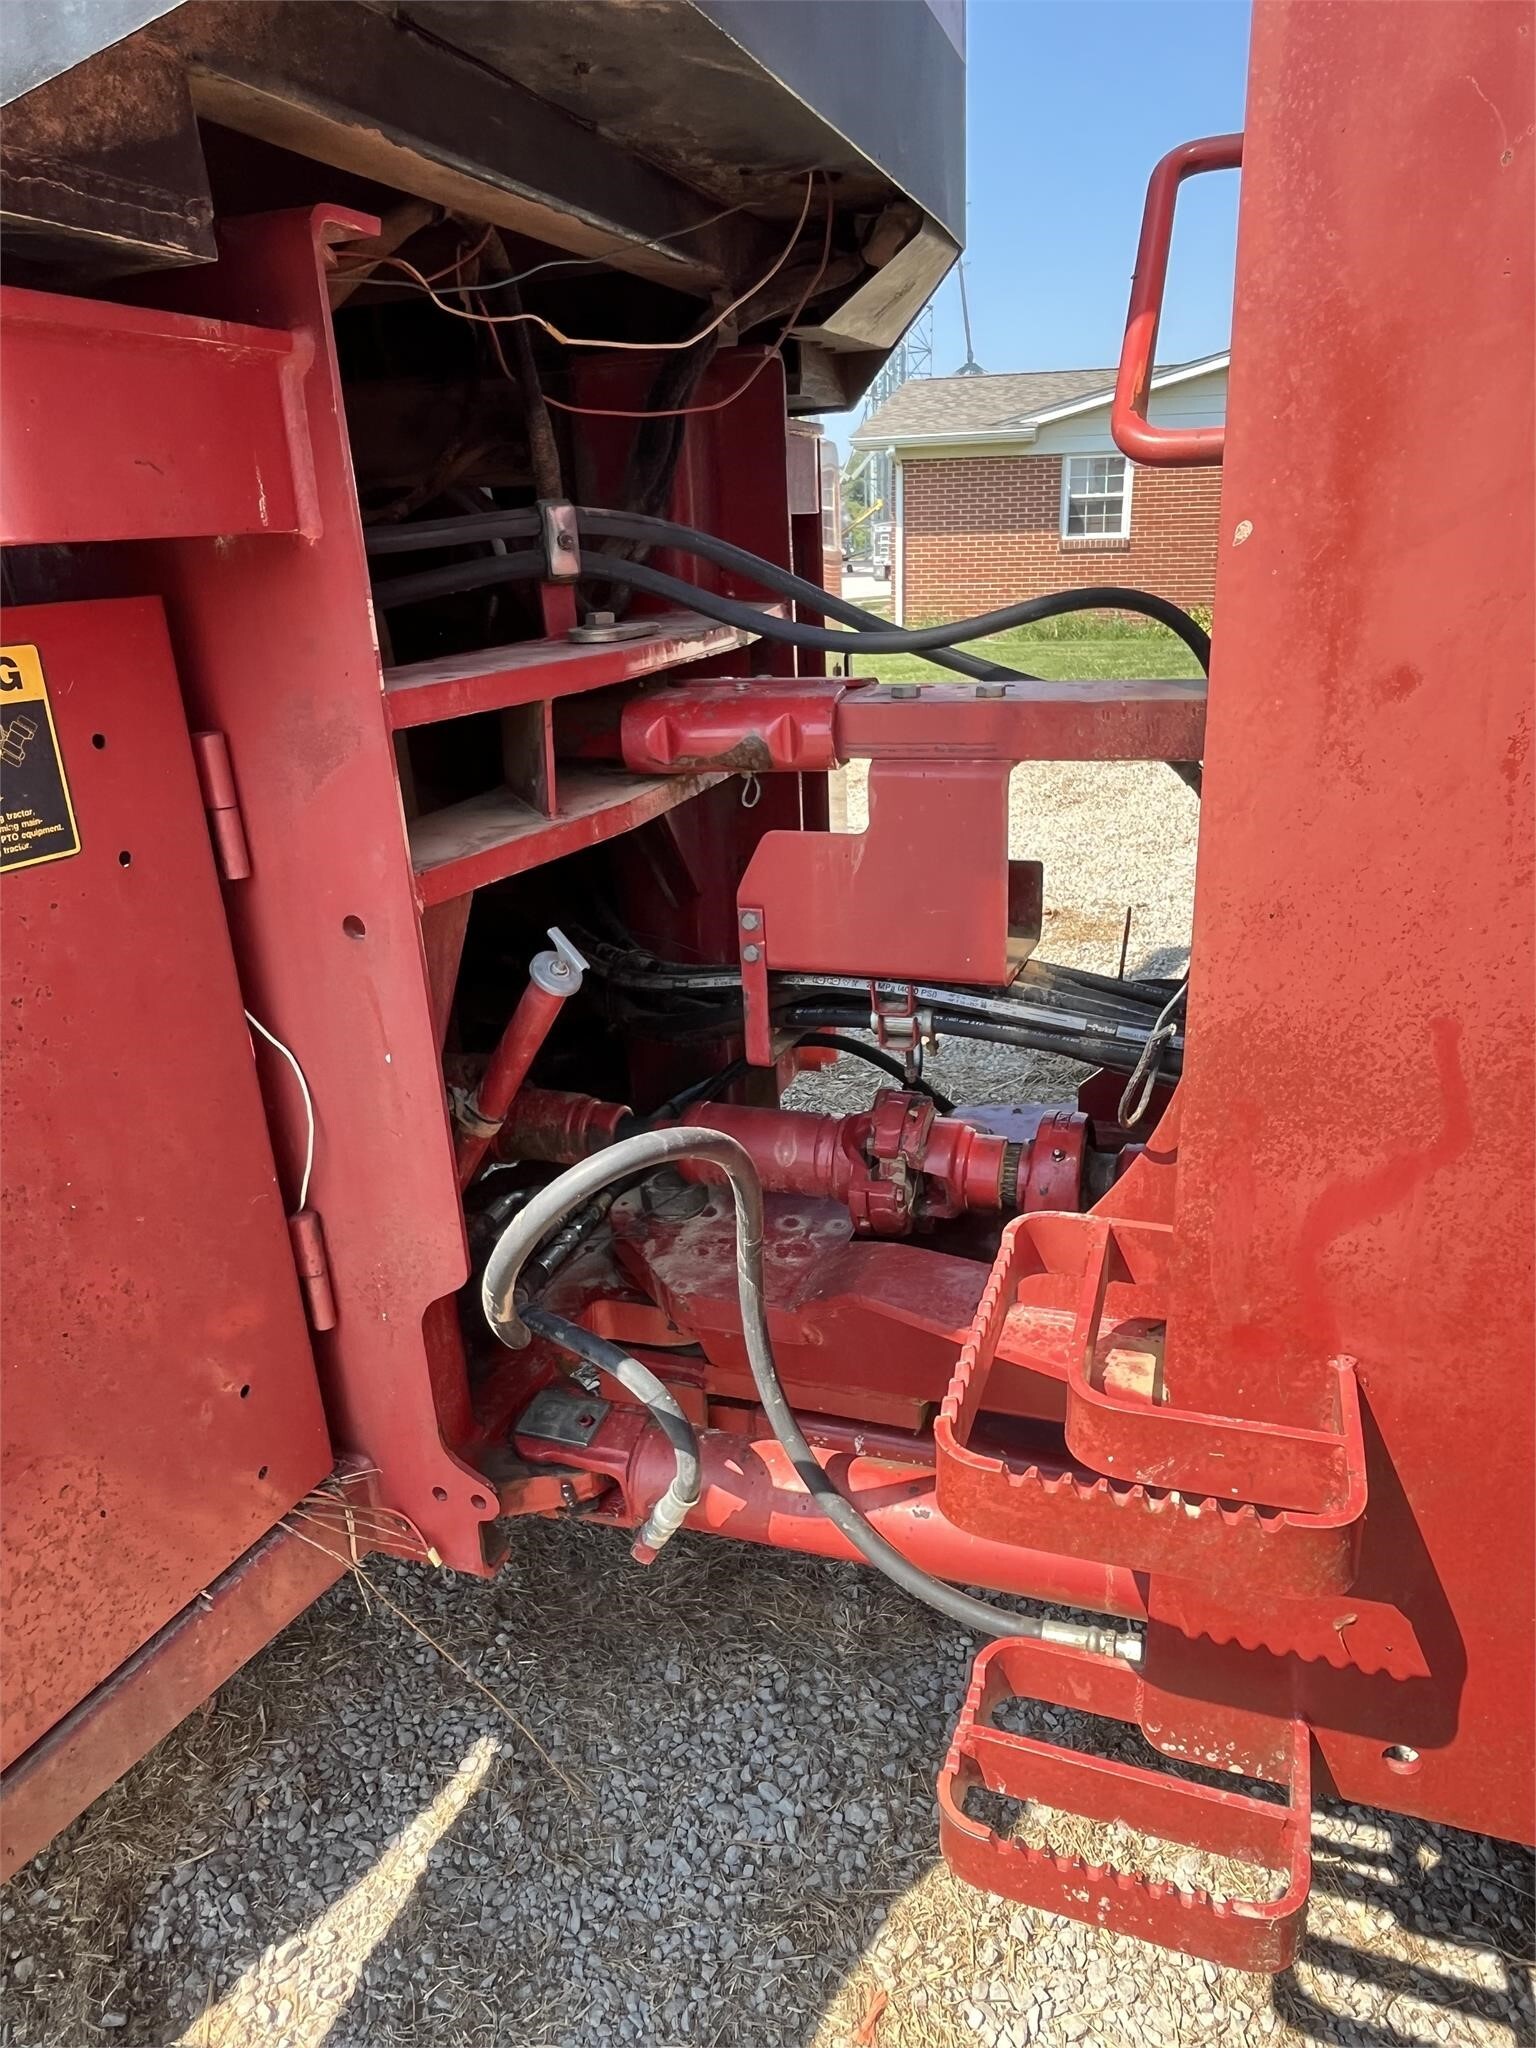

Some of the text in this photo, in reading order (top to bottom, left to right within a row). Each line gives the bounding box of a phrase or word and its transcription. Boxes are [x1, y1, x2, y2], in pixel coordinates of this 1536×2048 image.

[21, 818, 43, 828] main-
[0, 824, 65, 843] PTO equipment.
[3, 843, 33, 854] tractor.
[877, 982, 895, 992] MPa
